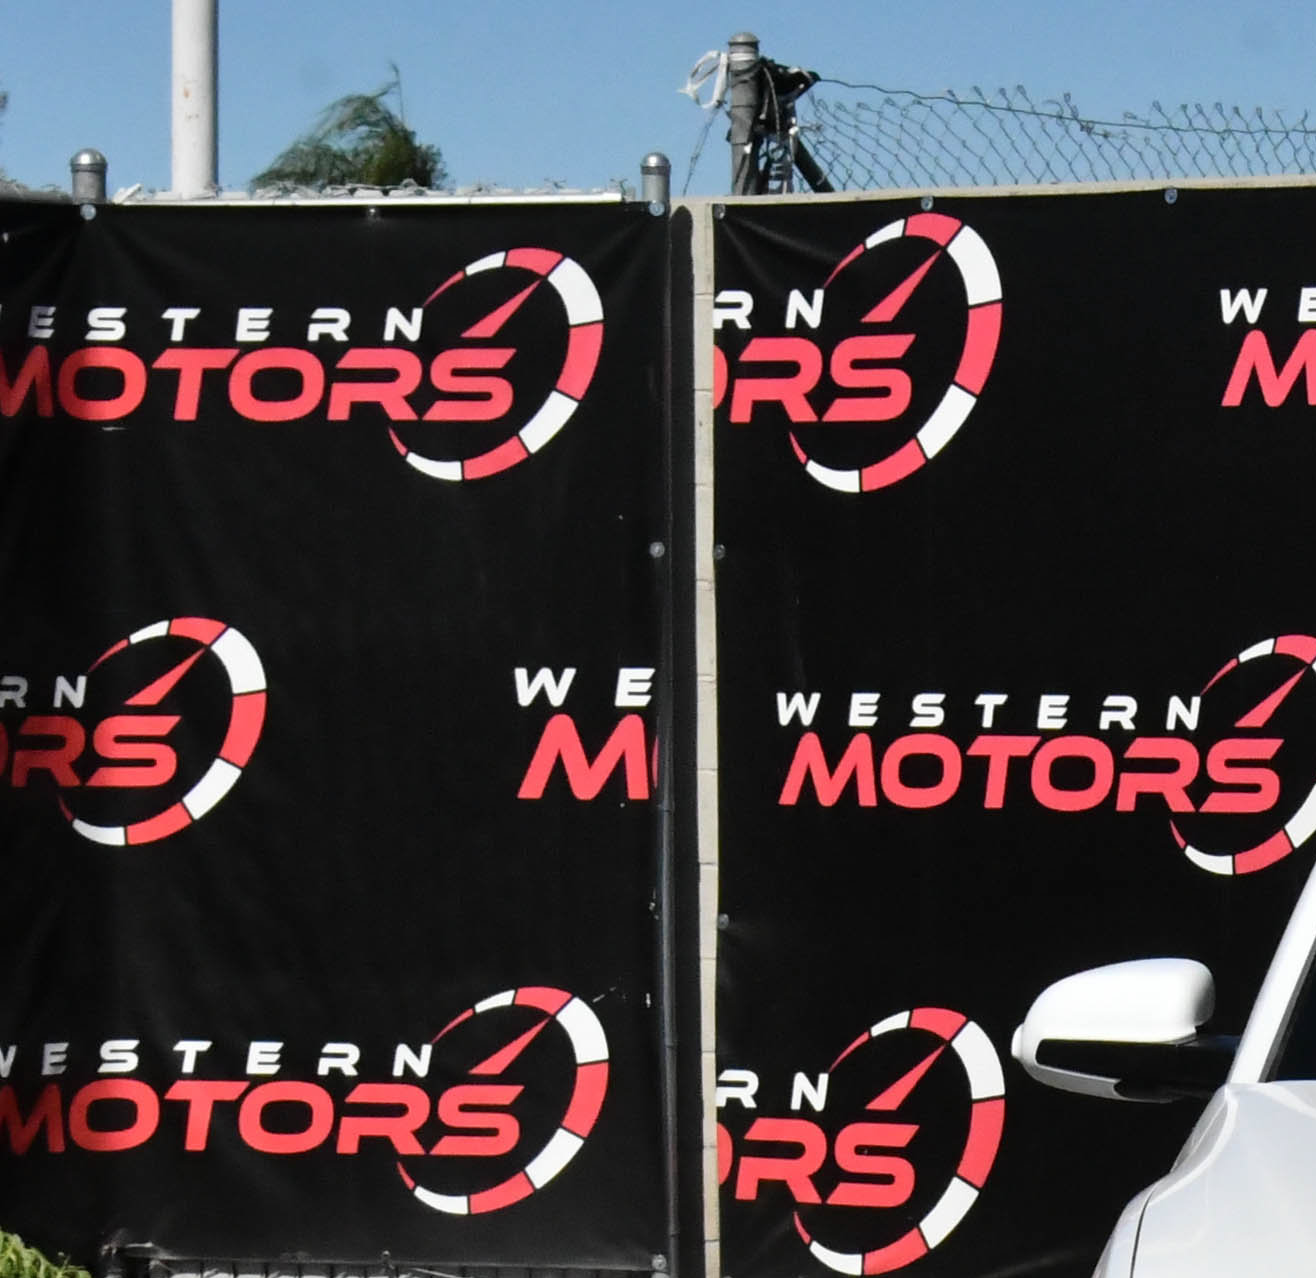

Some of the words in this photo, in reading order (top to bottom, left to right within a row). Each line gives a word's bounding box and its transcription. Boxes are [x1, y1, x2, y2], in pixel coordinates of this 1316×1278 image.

[0, 303, 424, 343] ESTERN
[776, 692, 1201, 731] WESTERN
[777, 732, 1284, 812] MOTORS
